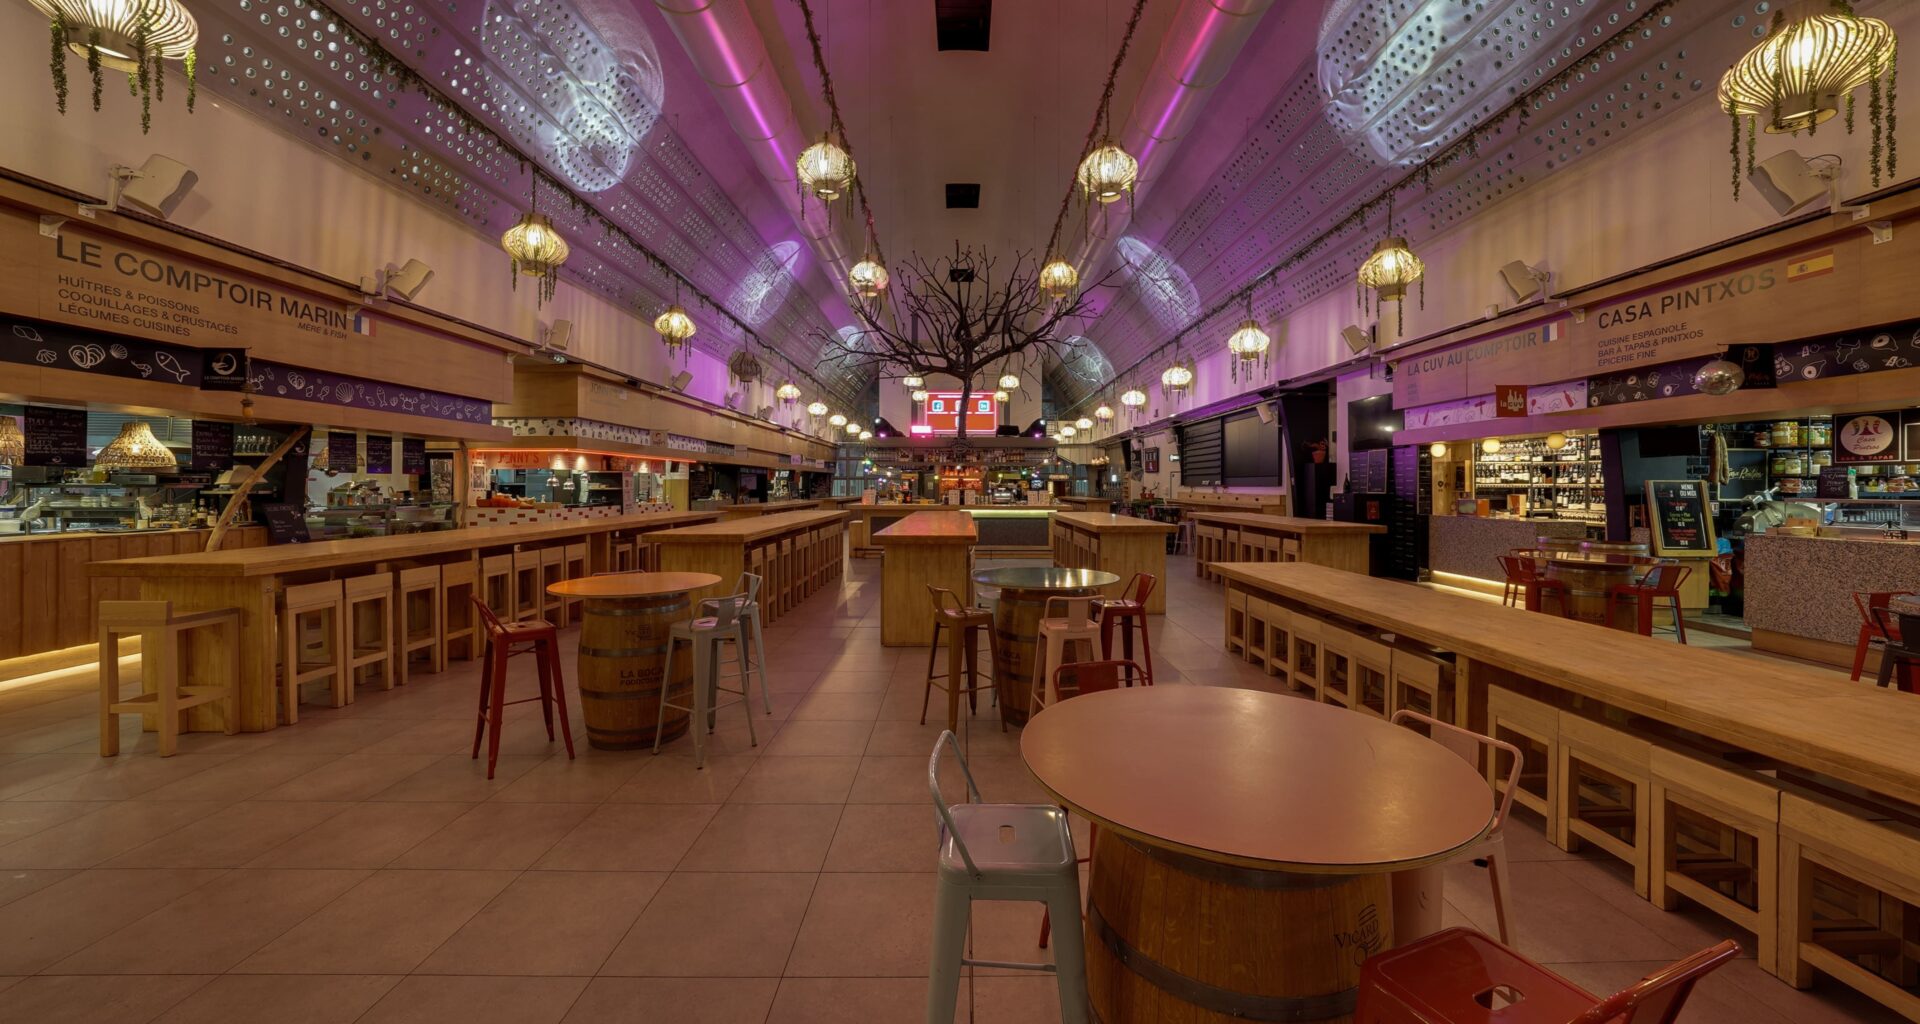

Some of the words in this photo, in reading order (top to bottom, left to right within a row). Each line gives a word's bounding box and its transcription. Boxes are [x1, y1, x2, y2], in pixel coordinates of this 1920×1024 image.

[57, 235, 102, 268] LE
[114, 252, 272, 311] COMPTOIR
[280, 296, 347, 330] MARIN
[58, 274, 121, 297] HUÎTRES
[125, 289, 134, 300] &
[138, 293, 200, 315] POISSONS
[1598, 301, 1652, 329] CASA
[1661, 268, 1776, 314] PINTXOS
[58, 288, 158, 317] COQUILLAGES
[162, 310, 170, 321] &
[173, 313, 239, 335] CRUSTACÉS
[58, 302, 130, 325] LÉGUMES
[133, 317, 191, 337] CUISINÉS
[1598, 334, 1631, 348] CUISINE
[1632, 322, 1687, 340] ESPAGNOLE
[1598, 347, 1615, 358] BAR
[1624, 340, 1651, 352] TAPAS
[1653, 339, 1660, 347] &
[1661, 329, 1704, 345] PINTXOS
[1408, 363, 1420, 376] LA
[1423, 355, 1444, 372] CUV
[1447, 352, 1463, 366] AU
[1467, 332, 1537, 361] COMPTOIR
[1637, 349, 1657, 359] FINE
[620, 669, 634, 678] LA
[1333, 919, 1379, 949] VICARD
